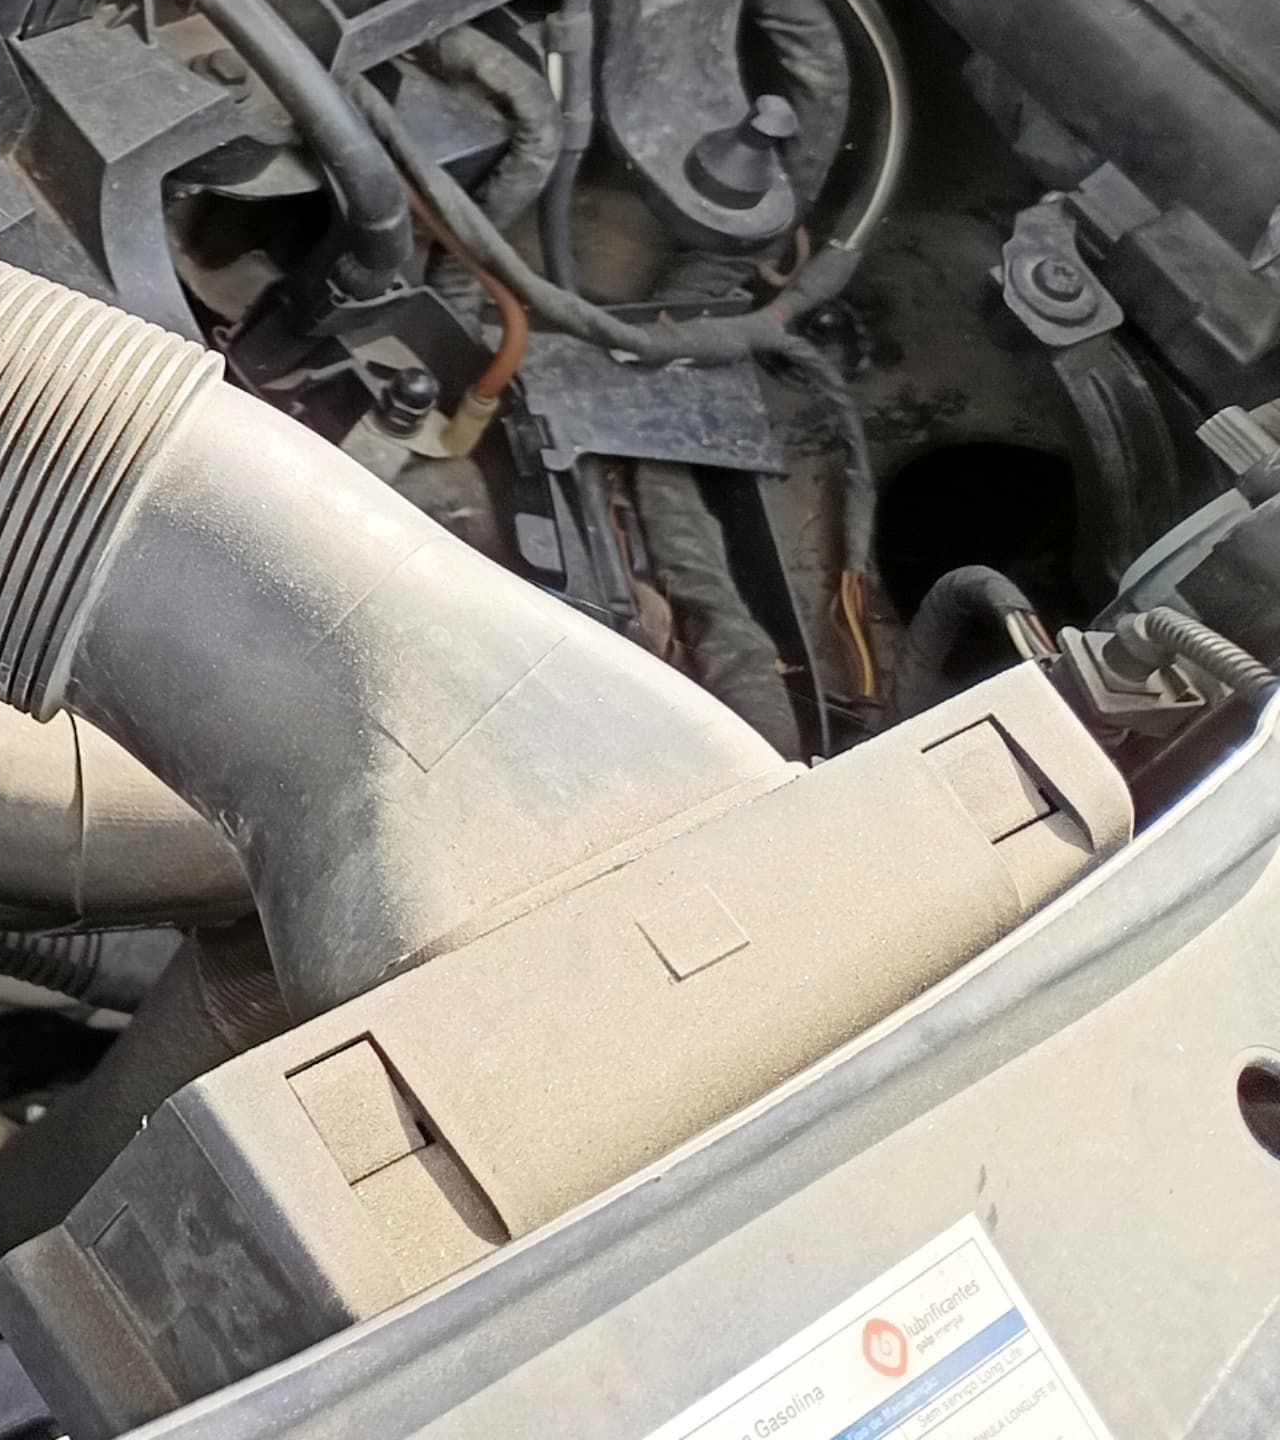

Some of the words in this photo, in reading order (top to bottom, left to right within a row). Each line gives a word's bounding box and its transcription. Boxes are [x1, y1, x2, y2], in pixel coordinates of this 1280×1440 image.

[902, 1279, 980, 1339] lubrificantes
[977, 1360, 1005, 1384] Long
[753, 1385, 826, 1435] Gasolina
